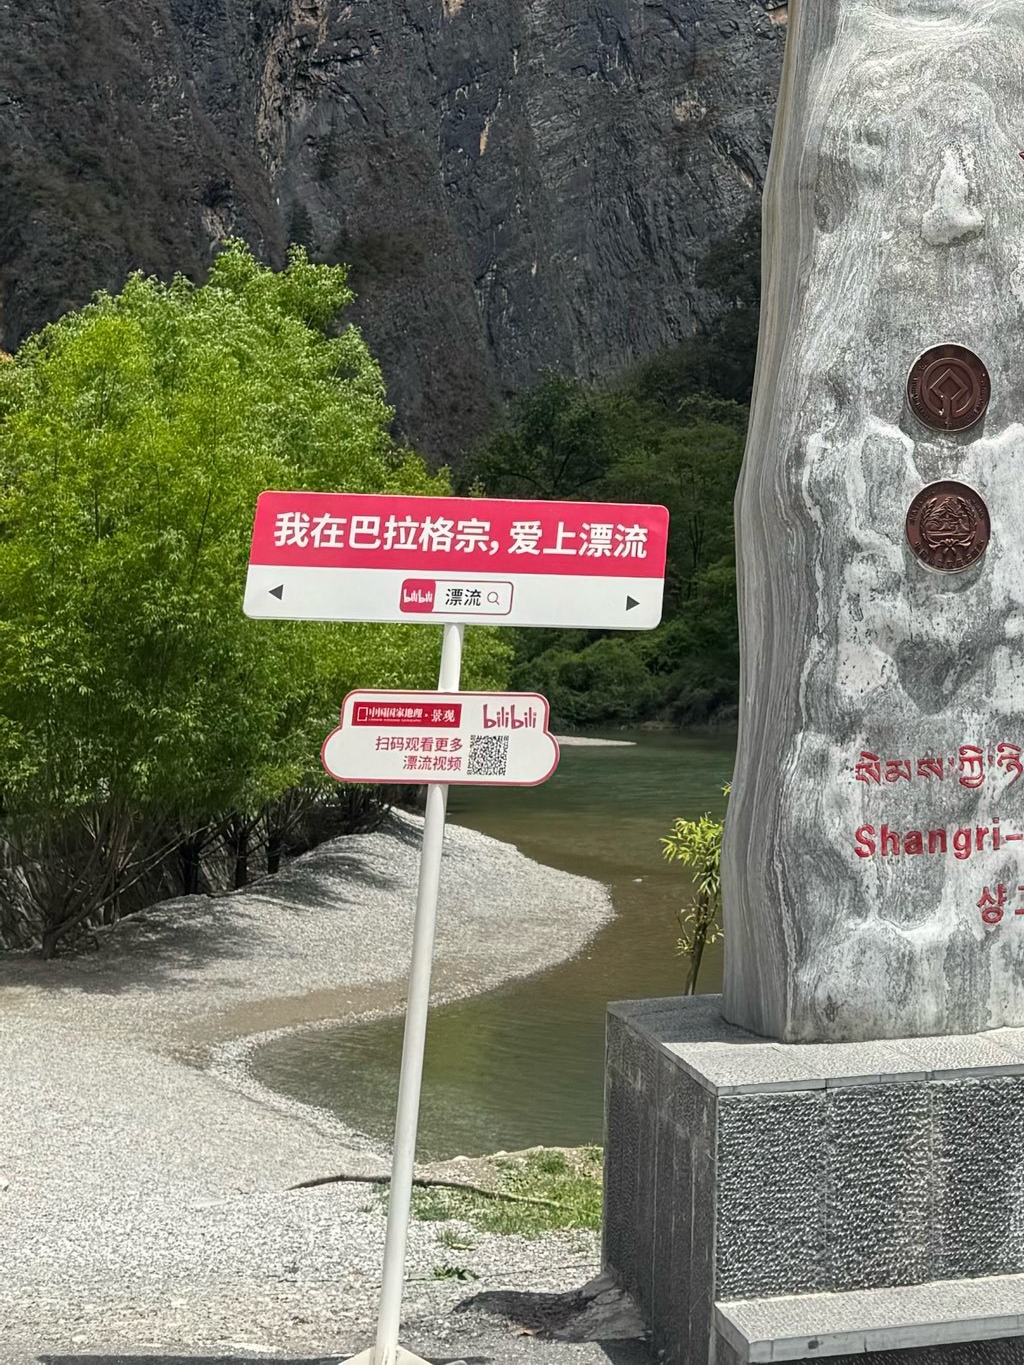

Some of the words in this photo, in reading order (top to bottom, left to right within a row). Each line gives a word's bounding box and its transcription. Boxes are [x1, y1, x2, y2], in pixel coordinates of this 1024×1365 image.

[445, 588, 482, 606] 漂流
[483, 703, 537, 729] bilibili
[375, 736, 463, 752] 扫码观看更多
[403, 755, 462, 771] 漂流视频
